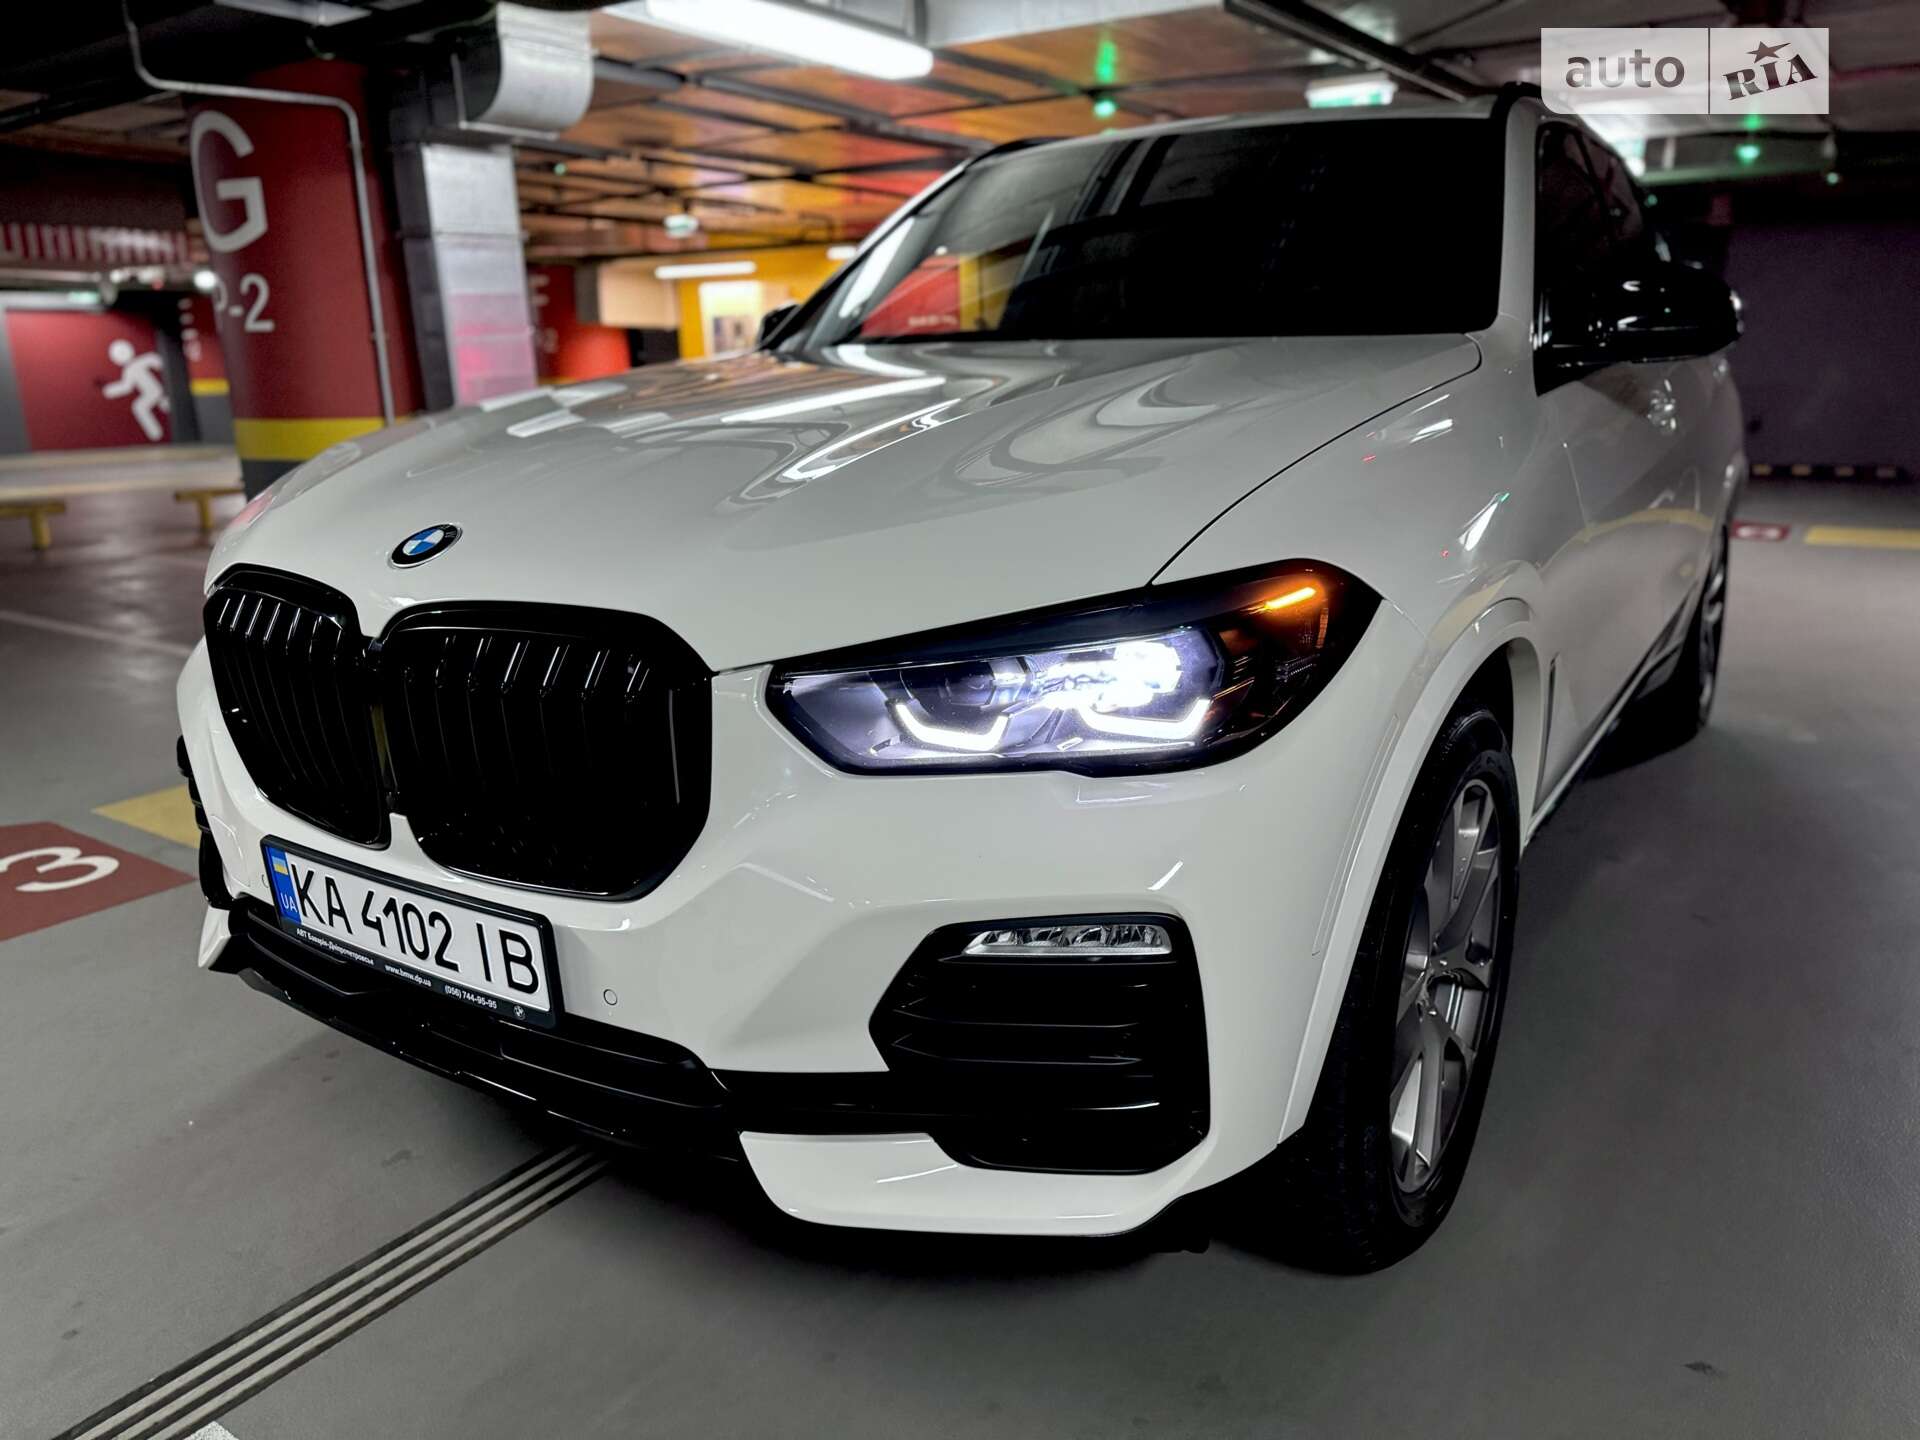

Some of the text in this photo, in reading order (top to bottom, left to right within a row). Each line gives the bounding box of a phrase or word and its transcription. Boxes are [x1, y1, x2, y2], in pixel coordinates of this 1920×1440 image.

[190, 110, 268, 253] G
[0, 846, 120, 892] 3
[280, 891, 298, 914] UA
[290, 863, 540, 994] KA 4102 IB
